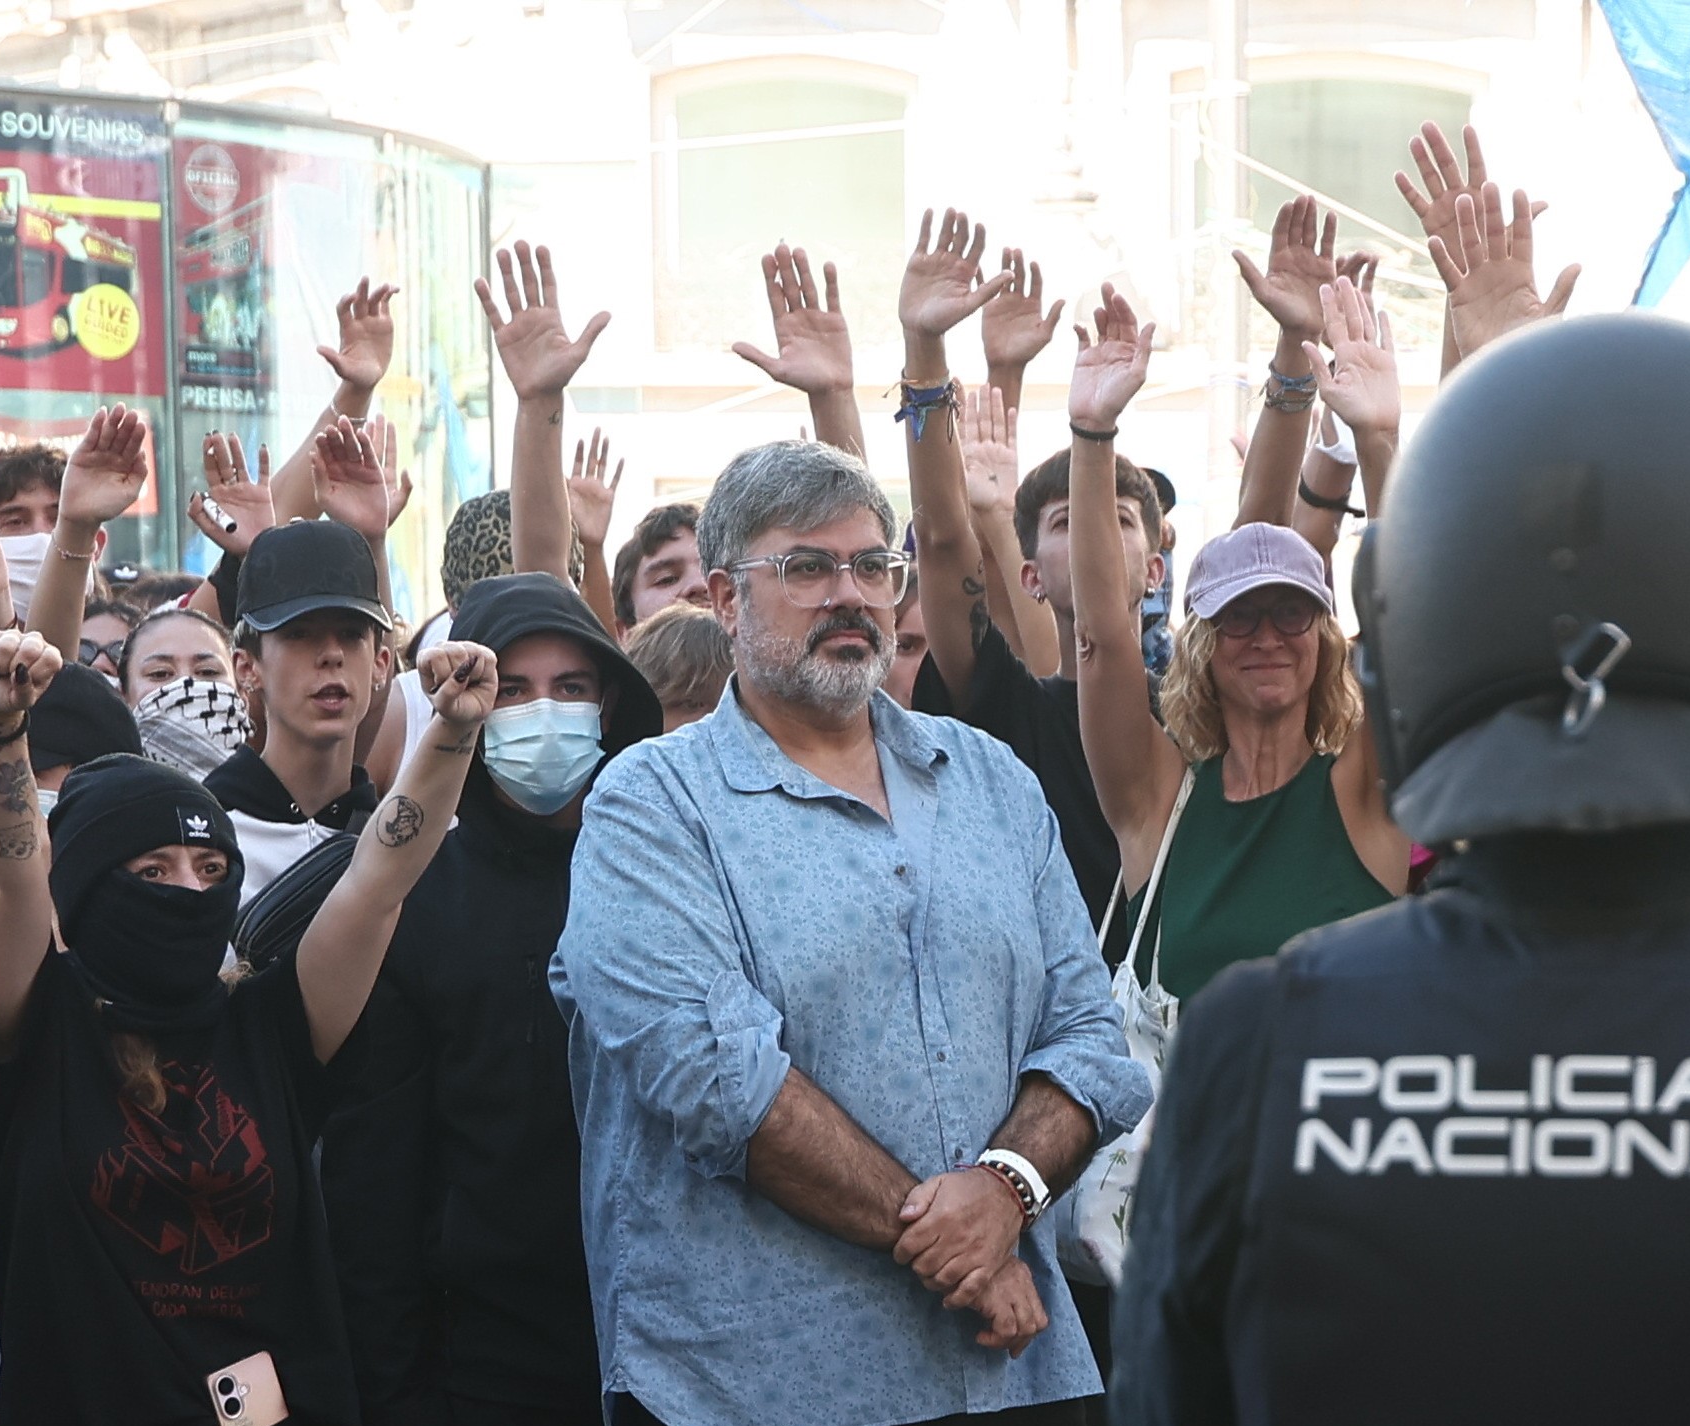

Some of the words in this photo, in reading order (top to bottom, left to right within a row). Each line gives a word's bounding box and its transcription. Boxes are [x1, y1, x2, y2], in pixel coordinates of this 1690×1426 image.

[0, 111, 145, 145] SOUVENIRS
[87, 294, 131, 325] LIVE
[181, 385, 257, 409] PRENSA
